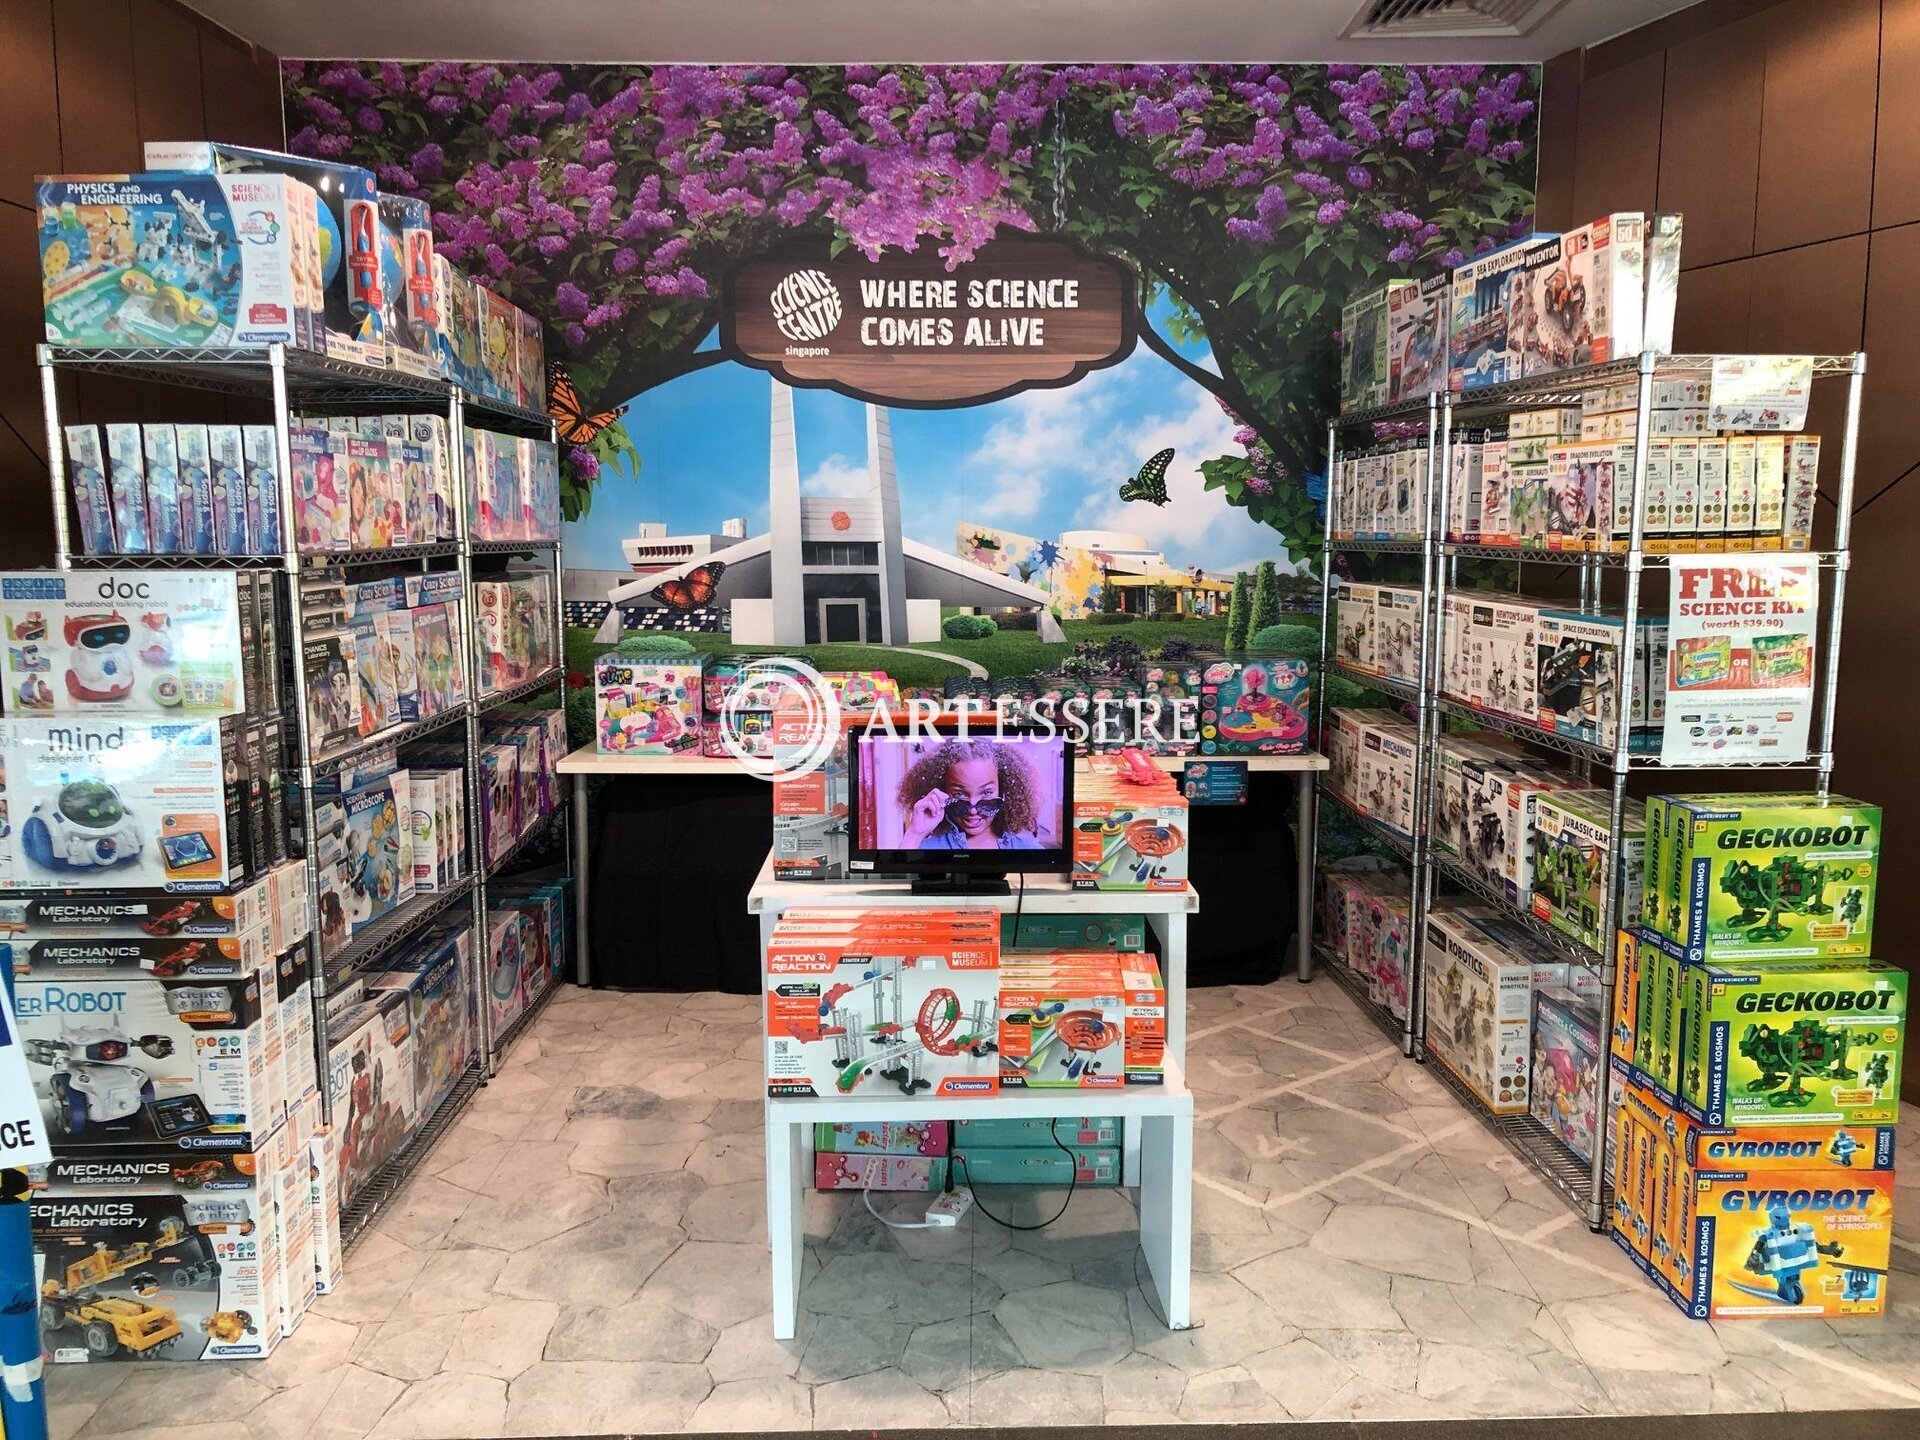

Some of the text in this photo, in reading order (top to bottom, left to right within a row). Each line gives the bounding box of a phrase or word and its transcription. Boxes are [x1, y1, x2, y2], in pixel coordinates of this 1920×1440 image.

[67, 184, 115, 194] PHYSICS
[231, 184, 272, 193] SCIEN
[81, 193, 163, 205] ENGINEERING
[1477, 249, 1527, 275] SEA EXPLORATION
[1525, 246, 1559, 267] INVENTOR
[770, 269, 837, 318] SCIENCE
[860, 279, 1079, 309] WHERE SCIENCE
[778, 290, 844, 342] CENTRE
[861, 317, 1044, 347] COMES ALIVE
[785, 345, 829, 357] singapore
[365, 448, 377, 456] GLOSS
[1589, 450, 1612, 458] EVOLUTION
[235, 480, 244, 505] Soaps
[99, 577, 149, 599] doc
[423, 580, 438, 591] Crazy
[1679, 567, 1807, 599] FRE
[359, 587, 373, 601] Crazy
[116, 600, 144, 609] talking
[1446, 600, 1470, 614] ECANICS
[1680, 602, 1766, 616] SCIENCE
[1496, 610, 1534, 623] NEWTON'S LAWS
[1563, 623, 1610, 638] SPACE EXPLORATION
[1702, 619, 1784, 629] (worth $39.90)
[304, 644, 327, 654] CHANICS
[307, 651, 330, 659] Laboratory
[49, 726, 124, 751] mind
[1383, 739, 1412, 758] MECHANICS
[37, 755, 85, 765] designer
[351, 792, 385, 814] MICROSCOPE
[1563, 816, 1594, 836] JURASSIC
[1717, 825, 1870, 849] GECKOBOT
[1651, 807, 1661, 892] GECKOBOT
[1674, 817, 1685, 904] GECKOBOT
[177, 882, 221, 892] Clementoni
[1695, 862, 1706, 900] KOSMOS
[40, 905, 135, 916] MECHANICS
[53, 915, 110, 924] Laboratory
[1693, 907, 1704, 946] THAMES
[44, 947, 140, 958] MECHANICS
[772, 954, 815, 962] ACTION
[952, 951, 986, 959] SCIENCE
[1449, 941, 1483, 975] ROBOTICS
[57, 957, 115, 965] Laboratory
[772, 963, 831, 972] REACTION
[952, 959, 989, 967] MUSEUM
[197, 966, 232, 974] Clementoni
[1621, 943, 1631, 1015] GYROBOT
[45, 987, 126, 1013] ROBOT
[172, 990, 224, 999] science
[1645, 953, 1655, 1035] GECKOBOT
[191, 1000, 220, 1010] play
[1663, 967, 1674, 1048] GECKOBOT
[1736, 990, 1895, 1013] GECKOBOT
[1538, 1001, 1599, 1055] Perfumes Cosmetics
[1693, 978, 1703, 1064] GECKOBOT
[1712, 1026, 1724, 1110] THAMES & KOSMOS
[1628, 1091, 1662, 1125] GYROBOT
[0, 1120, 34, 1150] CE
[192, 1137, 242, 1147] Clementoni
[1622, 1120, 1630, 1191] GYROBOT
[1709, 1141, 1822, 1158] GYROBOT
[57, 1164, 170, 1175] MECHANICS
[1639, 1136, 1647, 1209] GYROBOT
[73, 1175, 141, 1184] Laboratory
[1661, 1152, 1670, 1228] GYROBOT
[191, 1202, 243, 1211] science
[1721, 1188, 1875, 1212] GYROBOT
[30, 1204, 134, 1217] ECHANICS
[1681, 1171, 1689, 1248] GYROBOT
[51, 1216, 147, 1228] Laboratory
[196, 1211, 240, 1223] & play
[1823, 1215, 1867, 1223] THE SCIENCE
[1827, 1222, 1883, 1231] OF GYROSCOPES
[1698, 1220, 1710, 1302] THAMES & KOSMOS
[1835, 1275, 1841, 1284] 7
[220, 1346, 258, 1354] Clementoni
